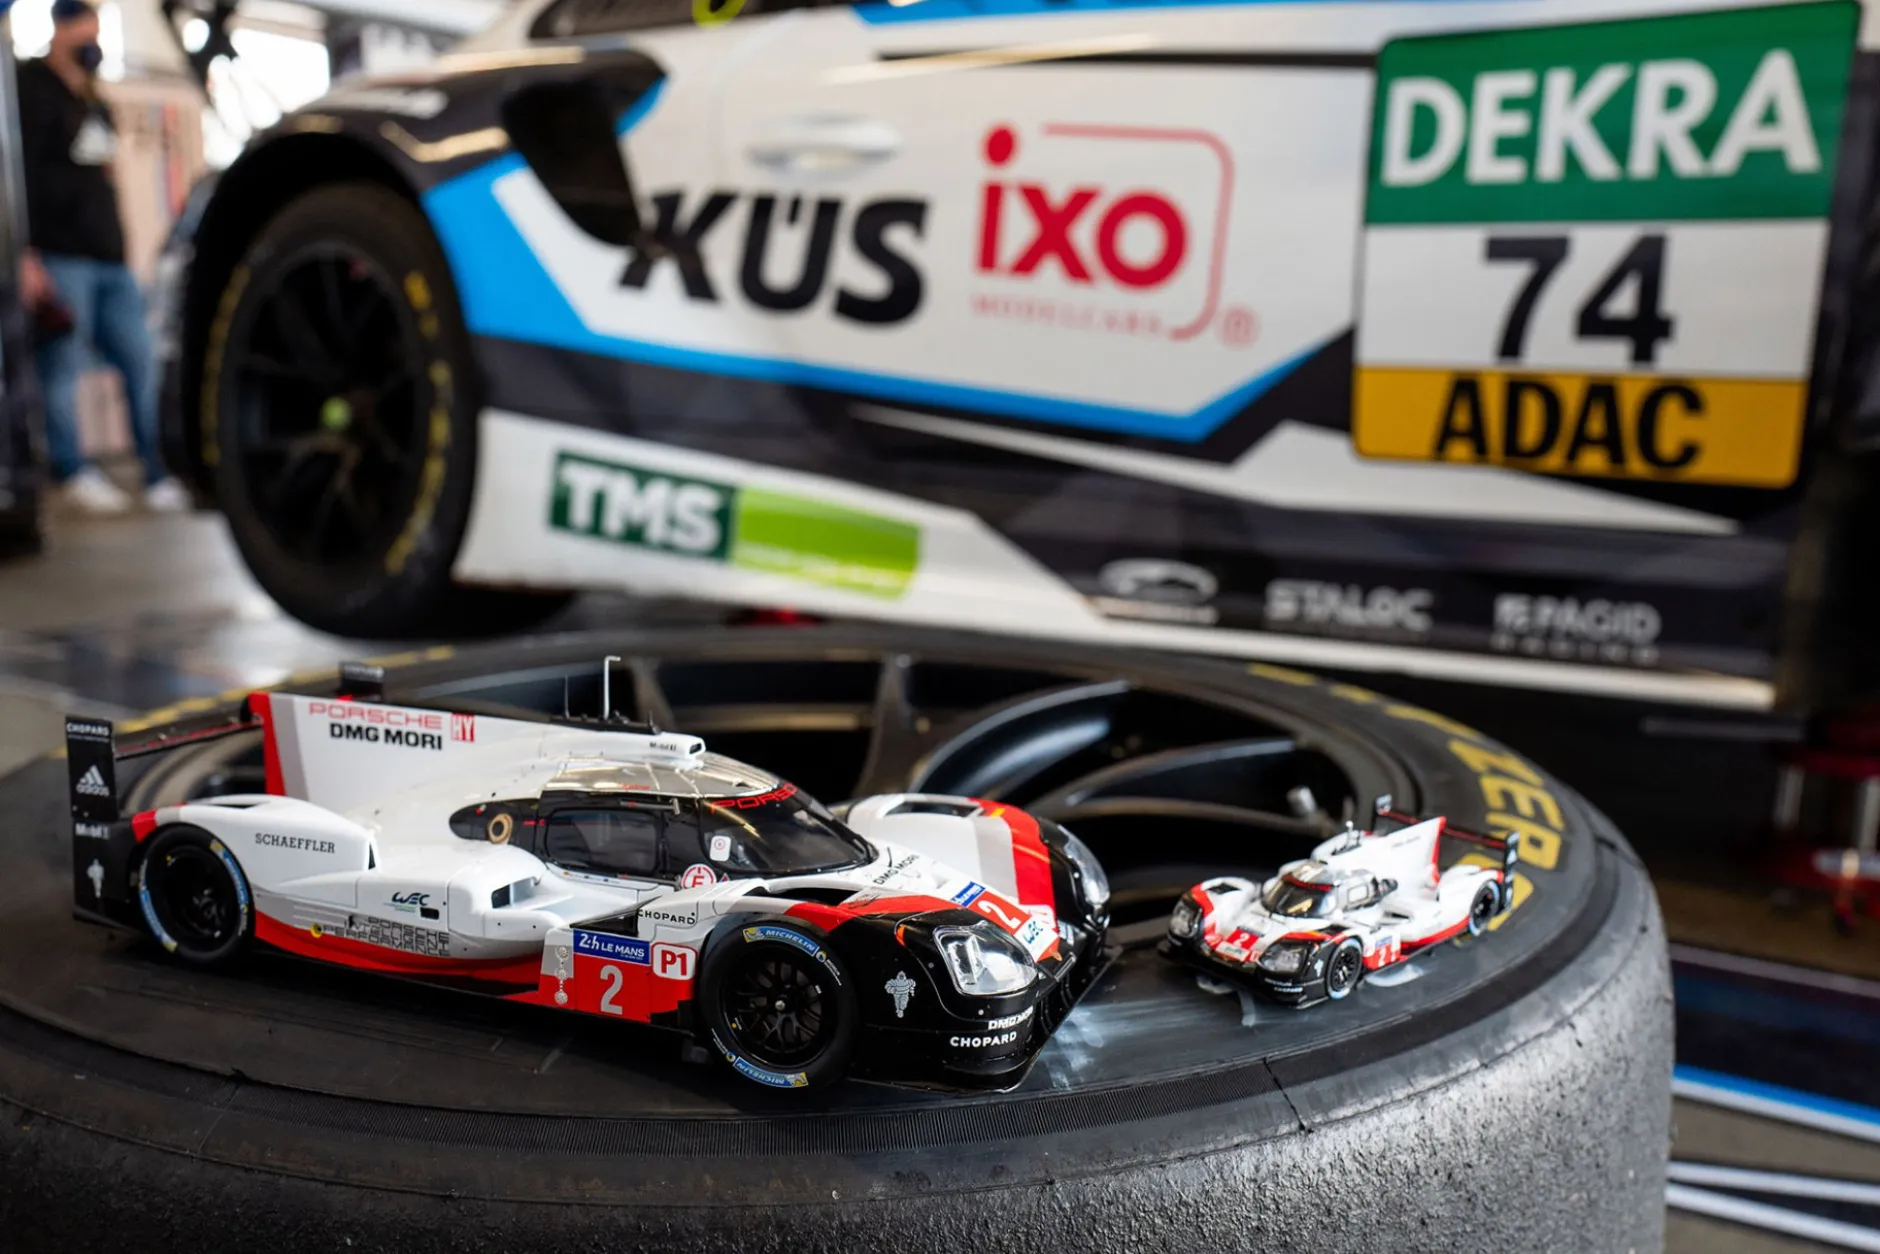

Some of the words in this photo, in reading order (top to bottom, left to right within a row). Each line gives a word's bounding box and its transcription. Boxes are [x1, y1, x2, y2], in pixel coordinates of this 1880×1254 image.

[1380, 48, 1822, 187] DEKRA
[616, 184, 931, 329] KÜS
[1482, 234, 1675, 368] 74
[1432, 370, 1708, 473] ADAC
[558, 458, 724, 555] TMS
[309, 702, 443, 730] PORSCHE
[330, 722, 379, 743] DMG
[384, 728, 443, 750] MORI
[255, 833, 335, 853] SCHAEFFLER
[391, 891, 430, 906] WEC
[636, 909, 696, 925] CHOPARD
[978, 899, 1021, 929] 2
[601, 942, 614, 952] LE
[615, 944, 645, 958] MANS
[765, 929, 816, 951] MICHELIN
[1234, 933, 1249, 948] 2
[660, 949, 688, 976] P1
[600, 964, 624, 1015] 2
[950, 1031, 1018, 1048] CHOPARD
[736, 1061, 786, 1085] MICHELIN
